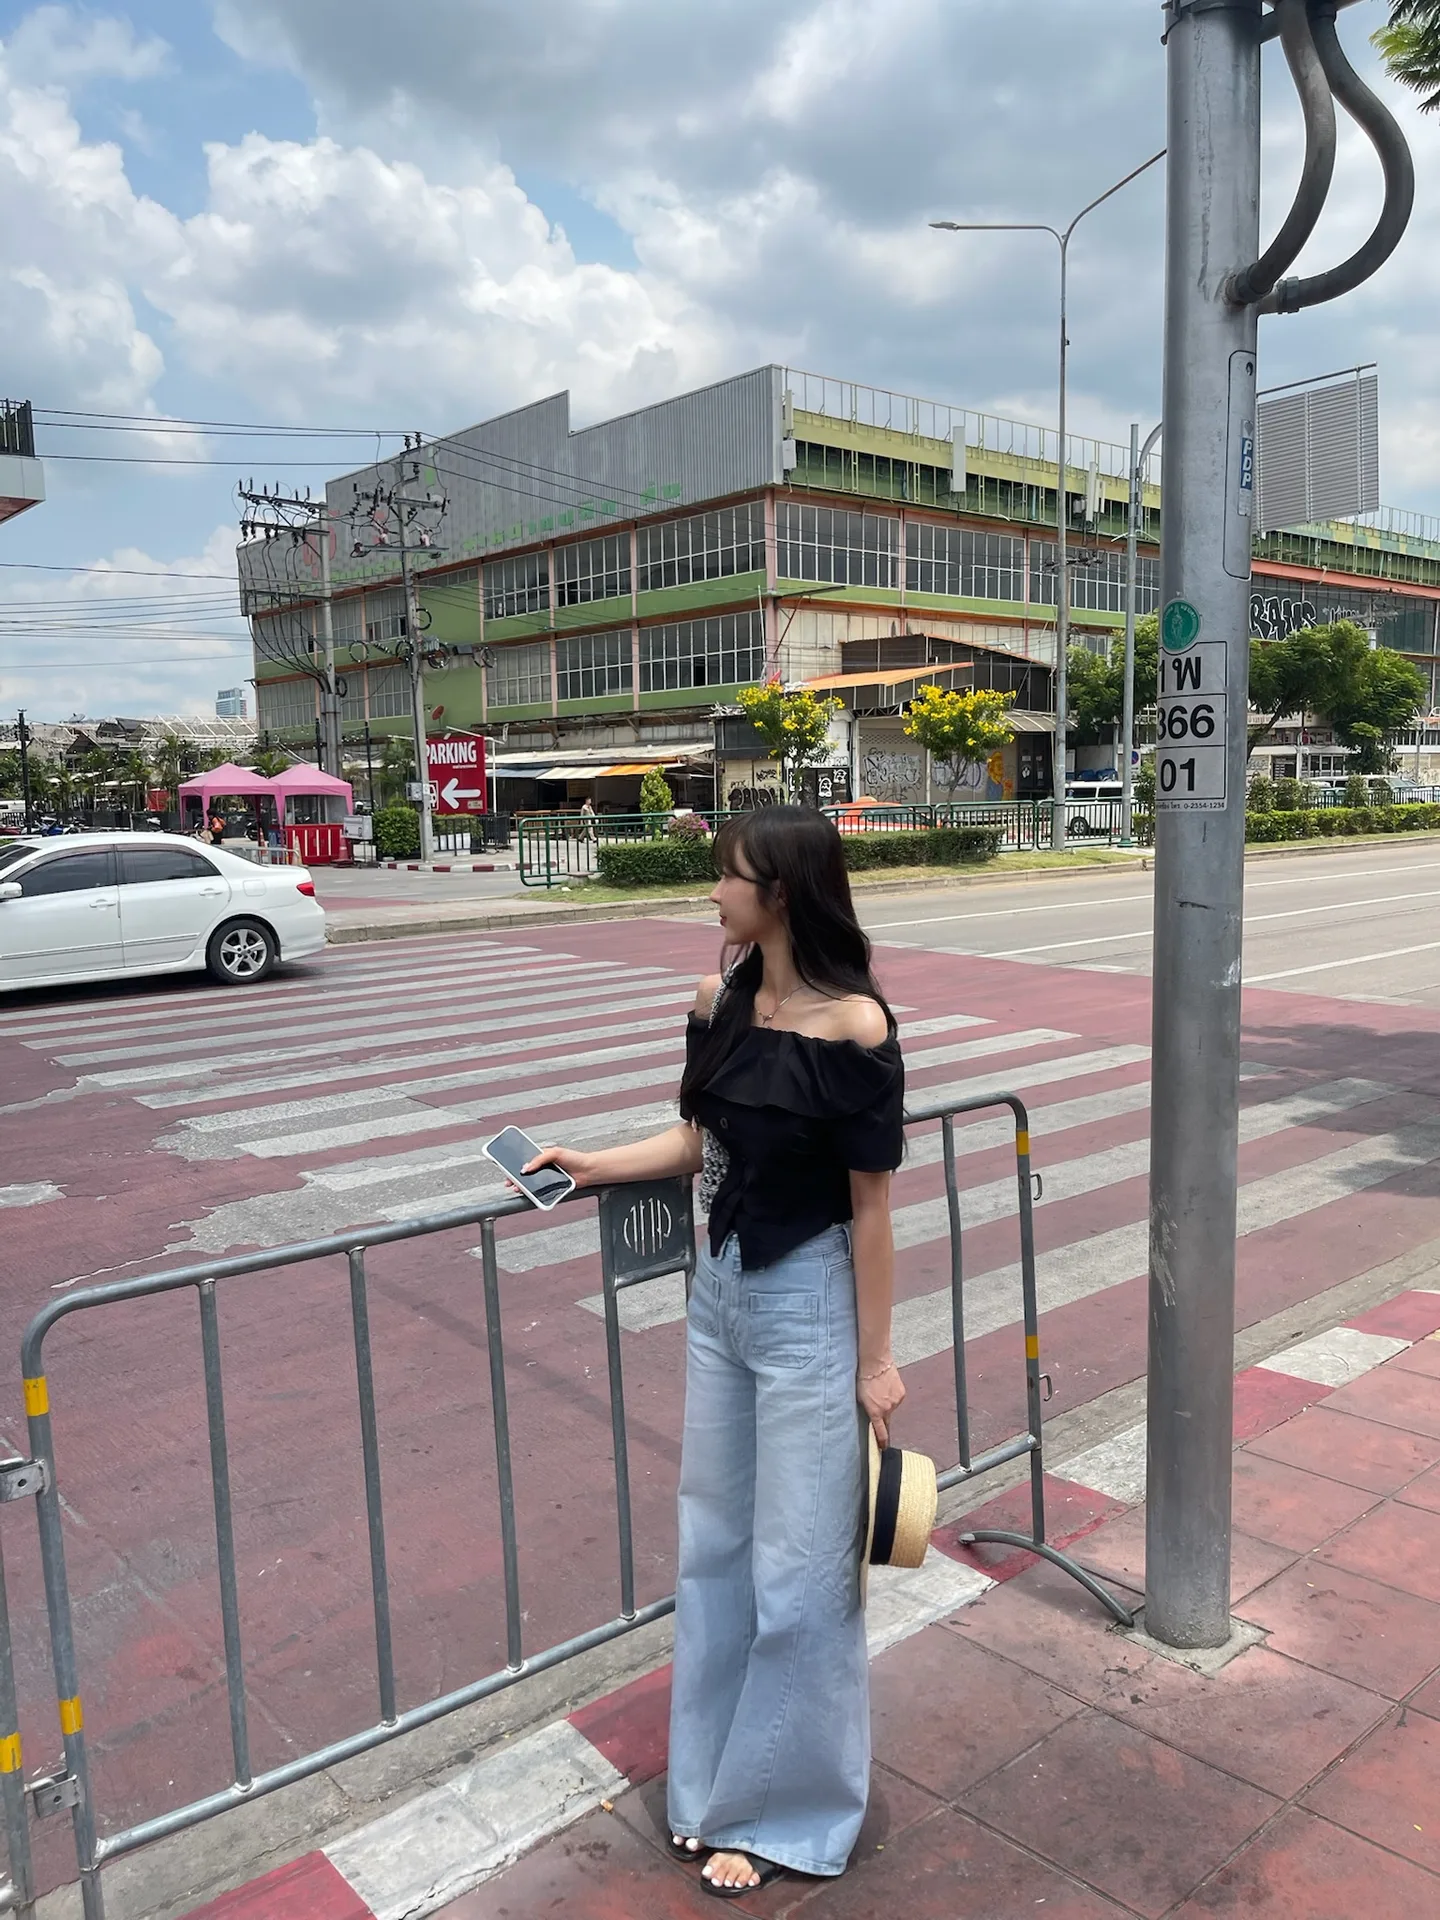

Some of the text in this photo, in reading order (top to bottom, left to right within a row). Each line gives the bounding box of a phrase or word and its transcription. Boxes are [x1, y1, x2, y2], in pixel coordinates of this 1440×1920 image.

[1241, 440, 1253, 488] PDP
[1157, 704, 1215, 741] 366
[1160, 757, 1195, 792] 01
